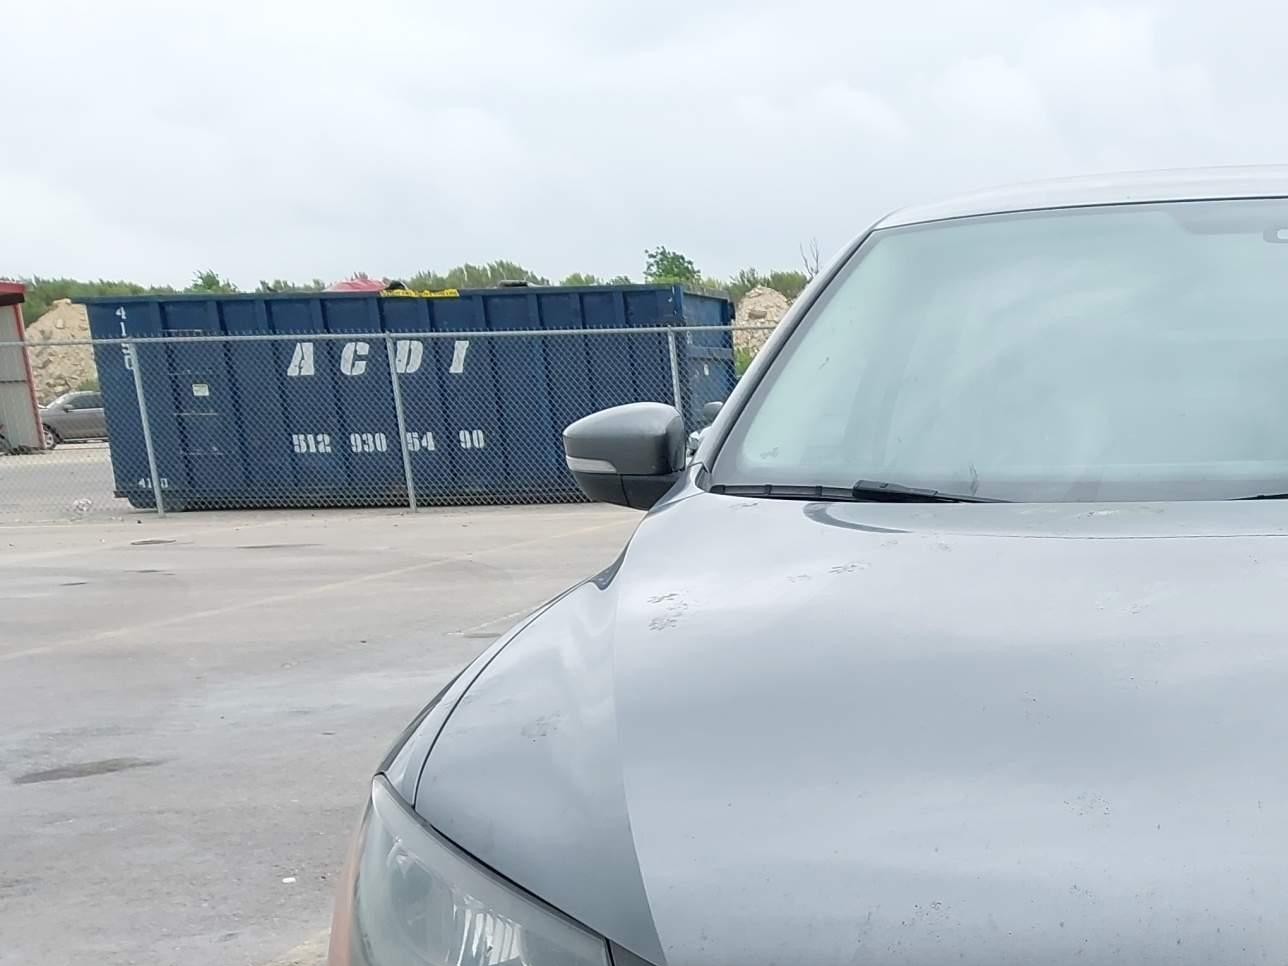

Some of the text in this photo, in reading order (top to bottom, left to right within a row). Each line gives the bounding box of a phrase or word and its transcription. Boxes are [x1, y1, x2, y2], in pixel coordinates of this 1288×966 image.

[292, 429, 485, 454] 512 930 54 90
[137, 478, 169, 489] 410
